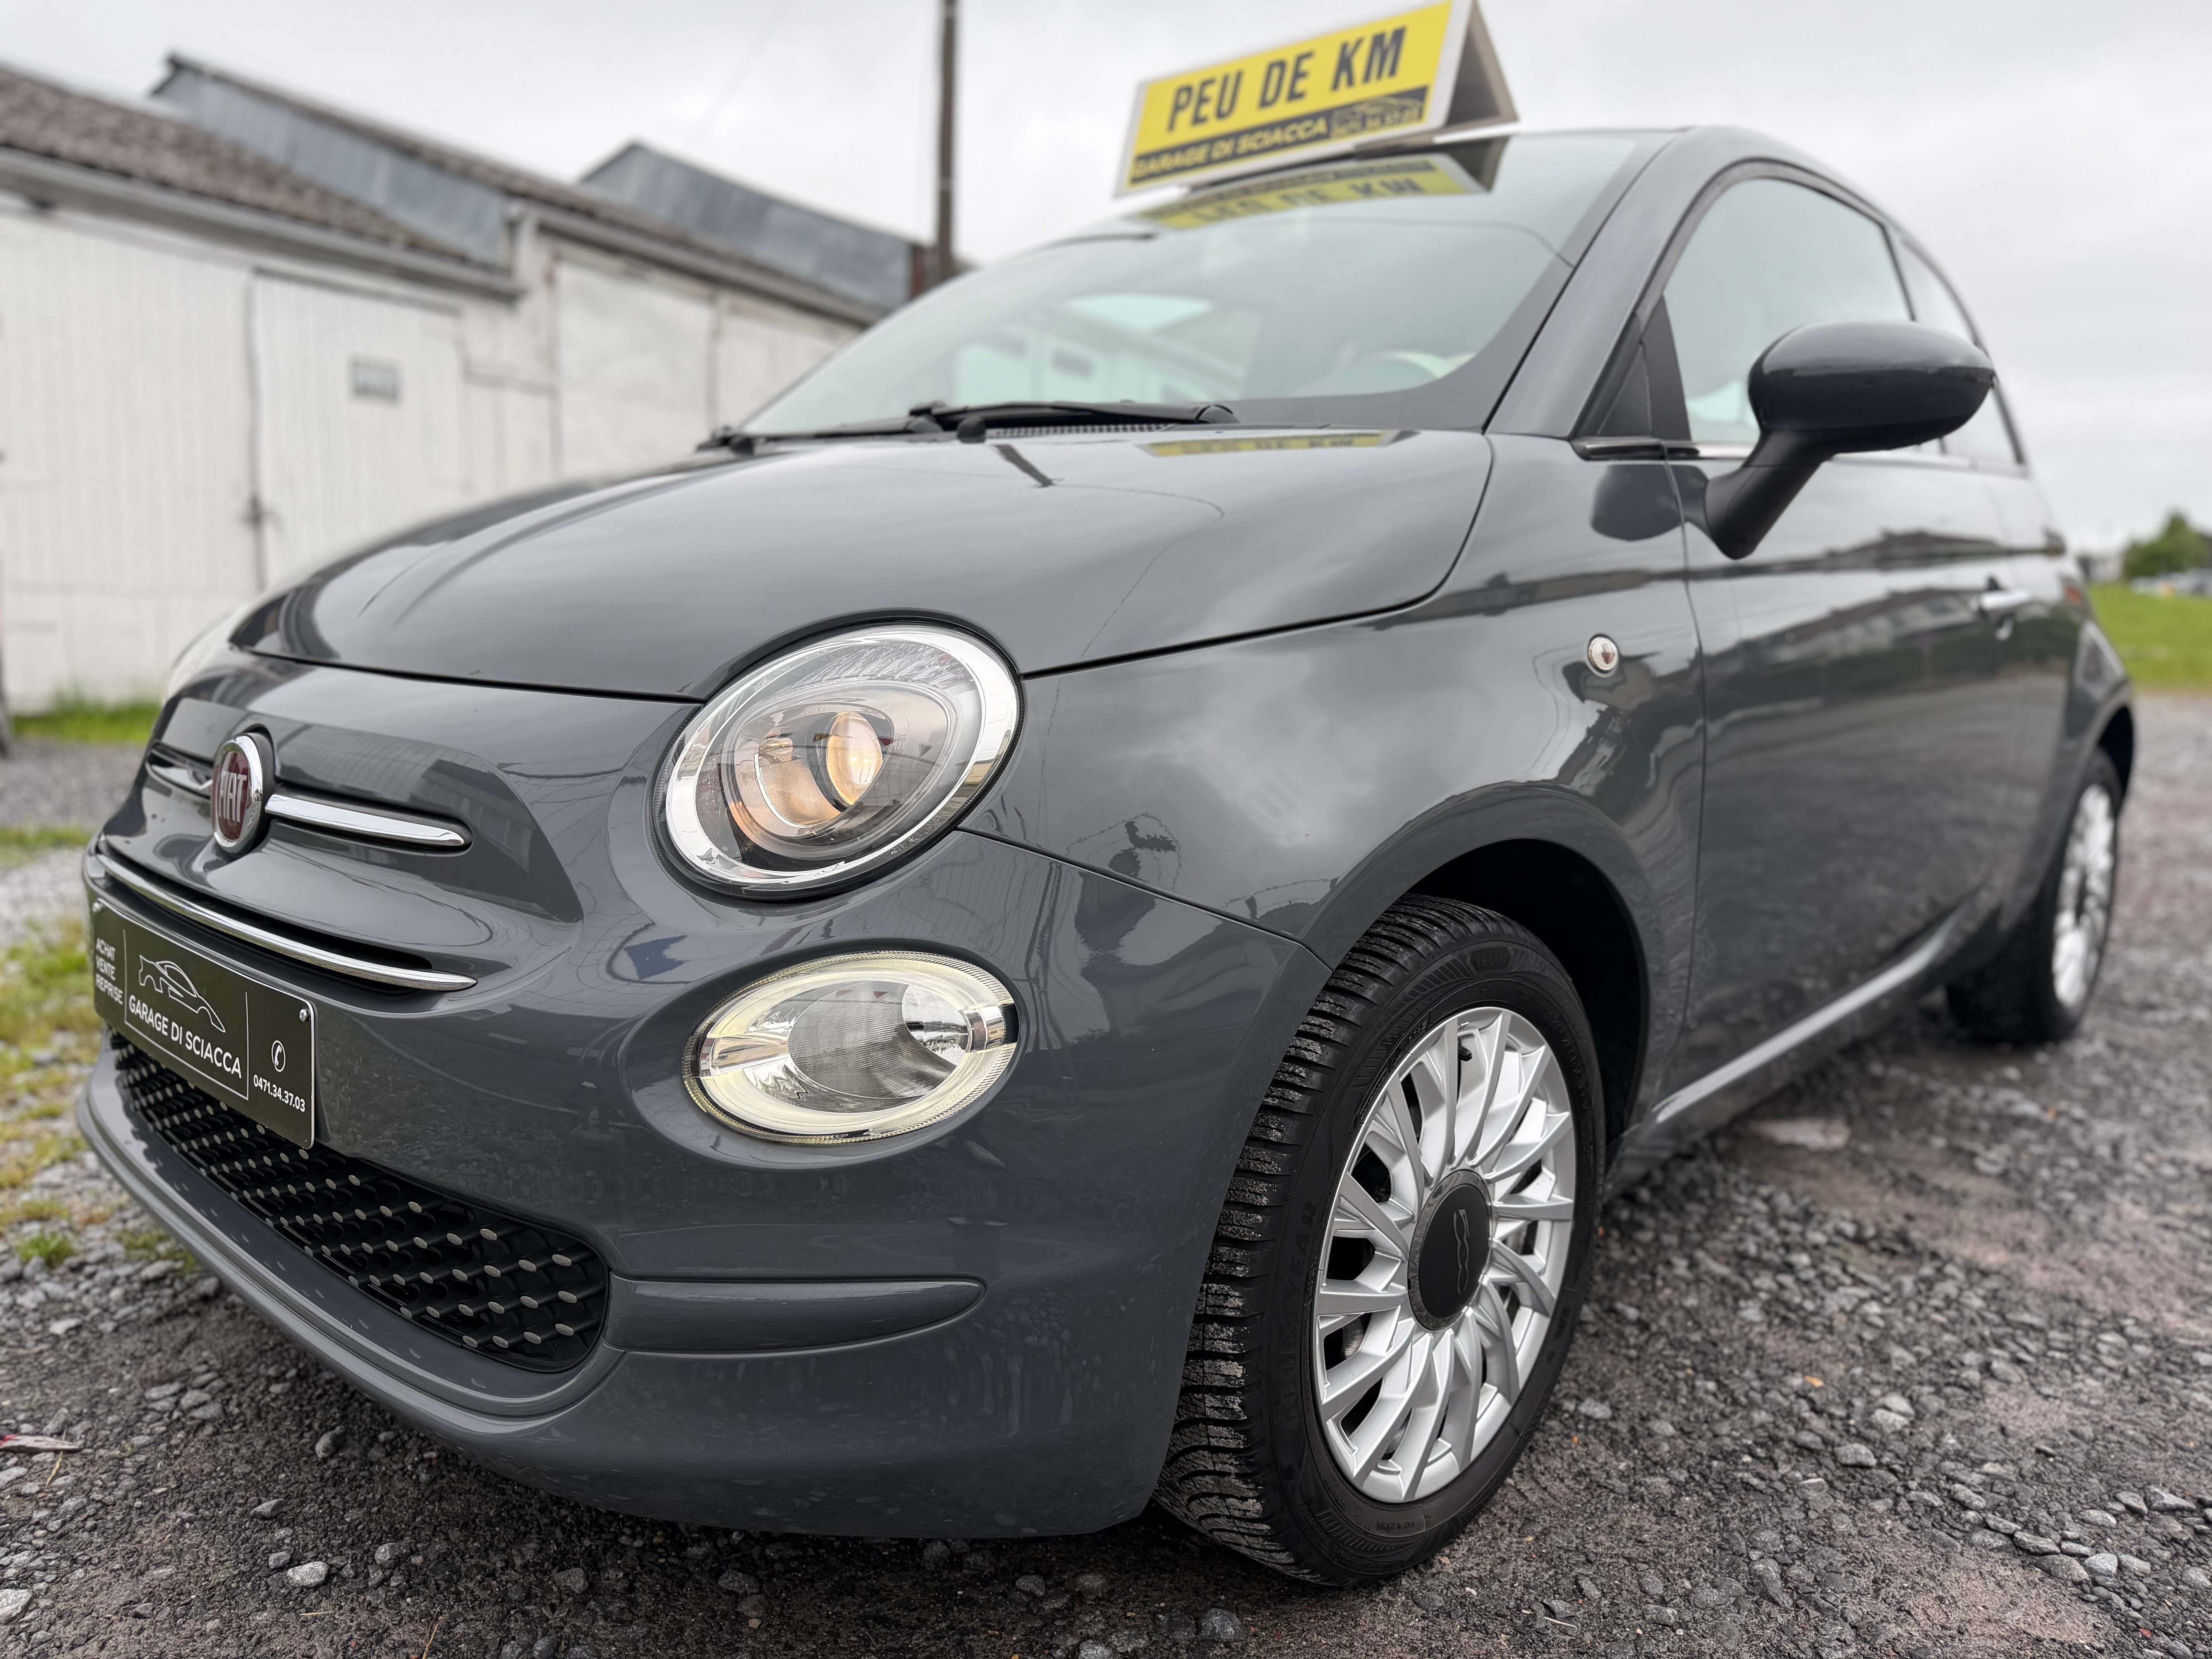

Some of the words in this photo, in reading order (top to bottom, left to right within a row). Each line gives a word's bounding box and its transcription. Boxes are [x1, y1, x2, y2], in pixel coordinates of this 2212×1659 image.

[1168, 70, 1243, 132] PEU
[1258, 52, 1314, 109] DE
[1330, 26, 1407, 92] KM
[1135, 145, 1209, 176] GARAGE
[1212, 139, 1235, 157] DI
[1239, 117, 1328, 151] SCIACCA
[96, 938, 115, 961] ACHAT
[96, 955, 115, 981] VENTE
[96, 973, 123, 1005] REPRISE
[129, 995, 168, 1036] GARAGE
[171, 1024, 182, 1044] DI
[185, 1031, 242, 1079] SCIACCA
[254, 1074, 306, 1112] 0471.34.37.03
